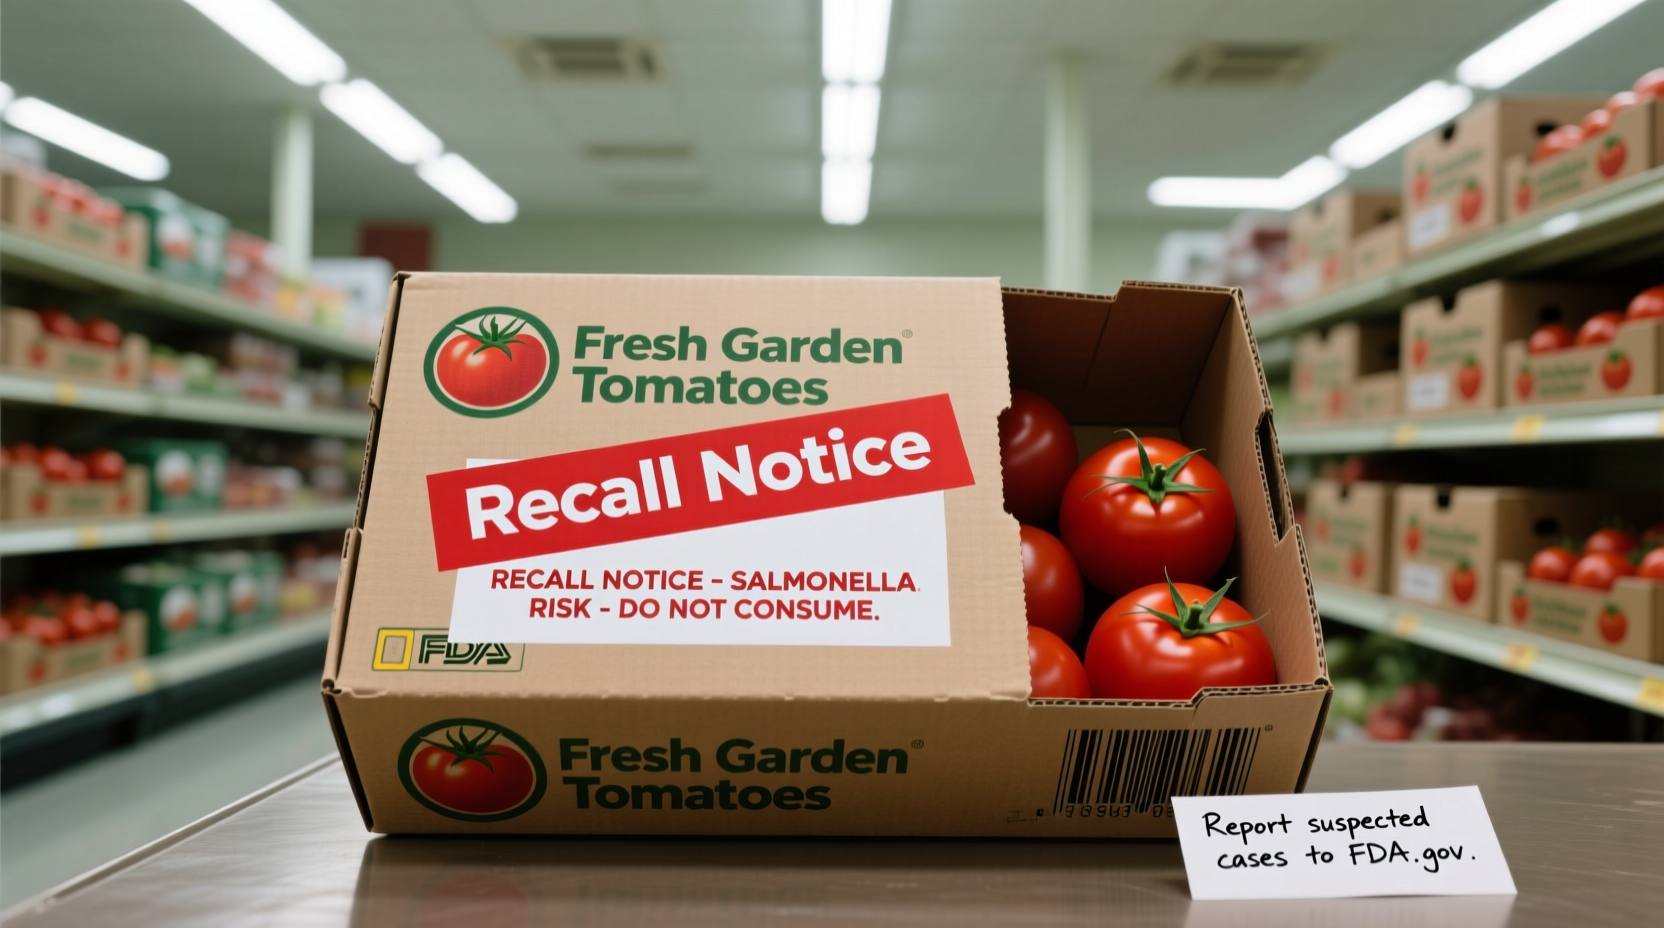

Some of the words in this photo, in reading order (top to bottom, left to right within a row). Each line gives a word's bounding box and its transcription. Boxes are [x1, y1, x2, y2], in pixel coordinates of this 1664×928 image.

[573, 325, 708, 362] Fresh
[571, 365, 830, 406] Tomatoes
[465, 455, 682, 539] Recall
[700, 427, 932, 502] Notice
[491, 569, 594, 590] RECALL
[602, 570, 703, 591] NOTICE
[529, 597, 591, 619] RISK
[619, 598, 661, 619] DO
[669, 599, 727, 620] NOT
[734, 598, 880, 621] CONSUME.
[418, 634, 512, 665] FDA
[559, 737, 703, 773] Fresh
[562, 775, 832, 812] Tomatoes
[1201, 811, 1293, 846] Report
[1307, 805, 1430, 840] suspected
[1217, 850, 1289, 870] cases
[1305, 845, 1335, 866] to
